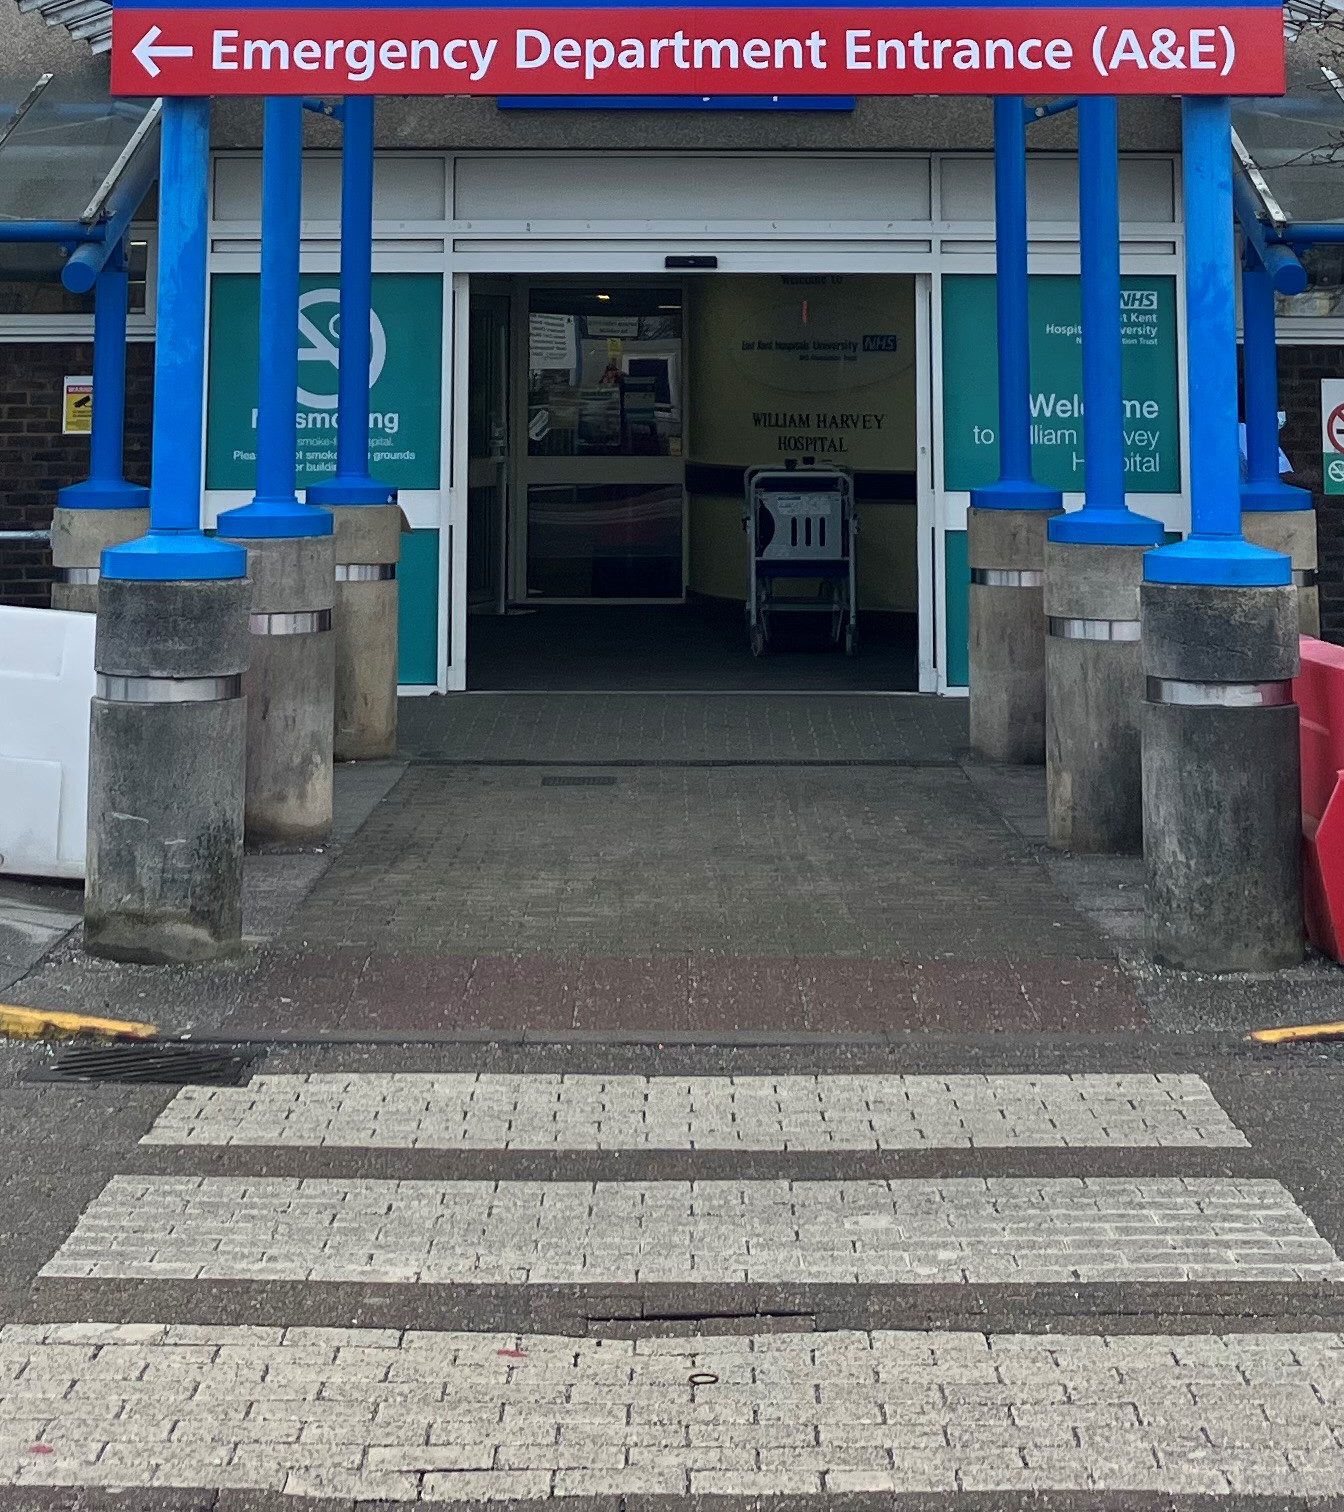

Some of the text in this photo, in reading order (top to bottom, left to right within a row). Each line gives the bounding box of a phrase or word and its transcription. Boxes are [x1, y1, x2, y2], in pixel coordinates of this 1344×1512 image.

[213, 26, 1235, 81] Emergency Department Entrance (A&E)
[1120, 292, 1155, 307] NHS
[1131, 313, 1157, 323] Kent
[1046, 324, 1157, 337] Hospit versity
[813, 341, 858, 353] University
[863, 336, 896, 351] NHS
[1029, 394, 1159, 418] Welme
[752, 412, 885, 429] WILLIAM HARVEY
[778, 436, 849, 453] HOSPITAL
[973, 425, 1159, 450] to lliam vey
[233, 450, 257, 460] Plea
[373, 451, 416, 462] grounds
